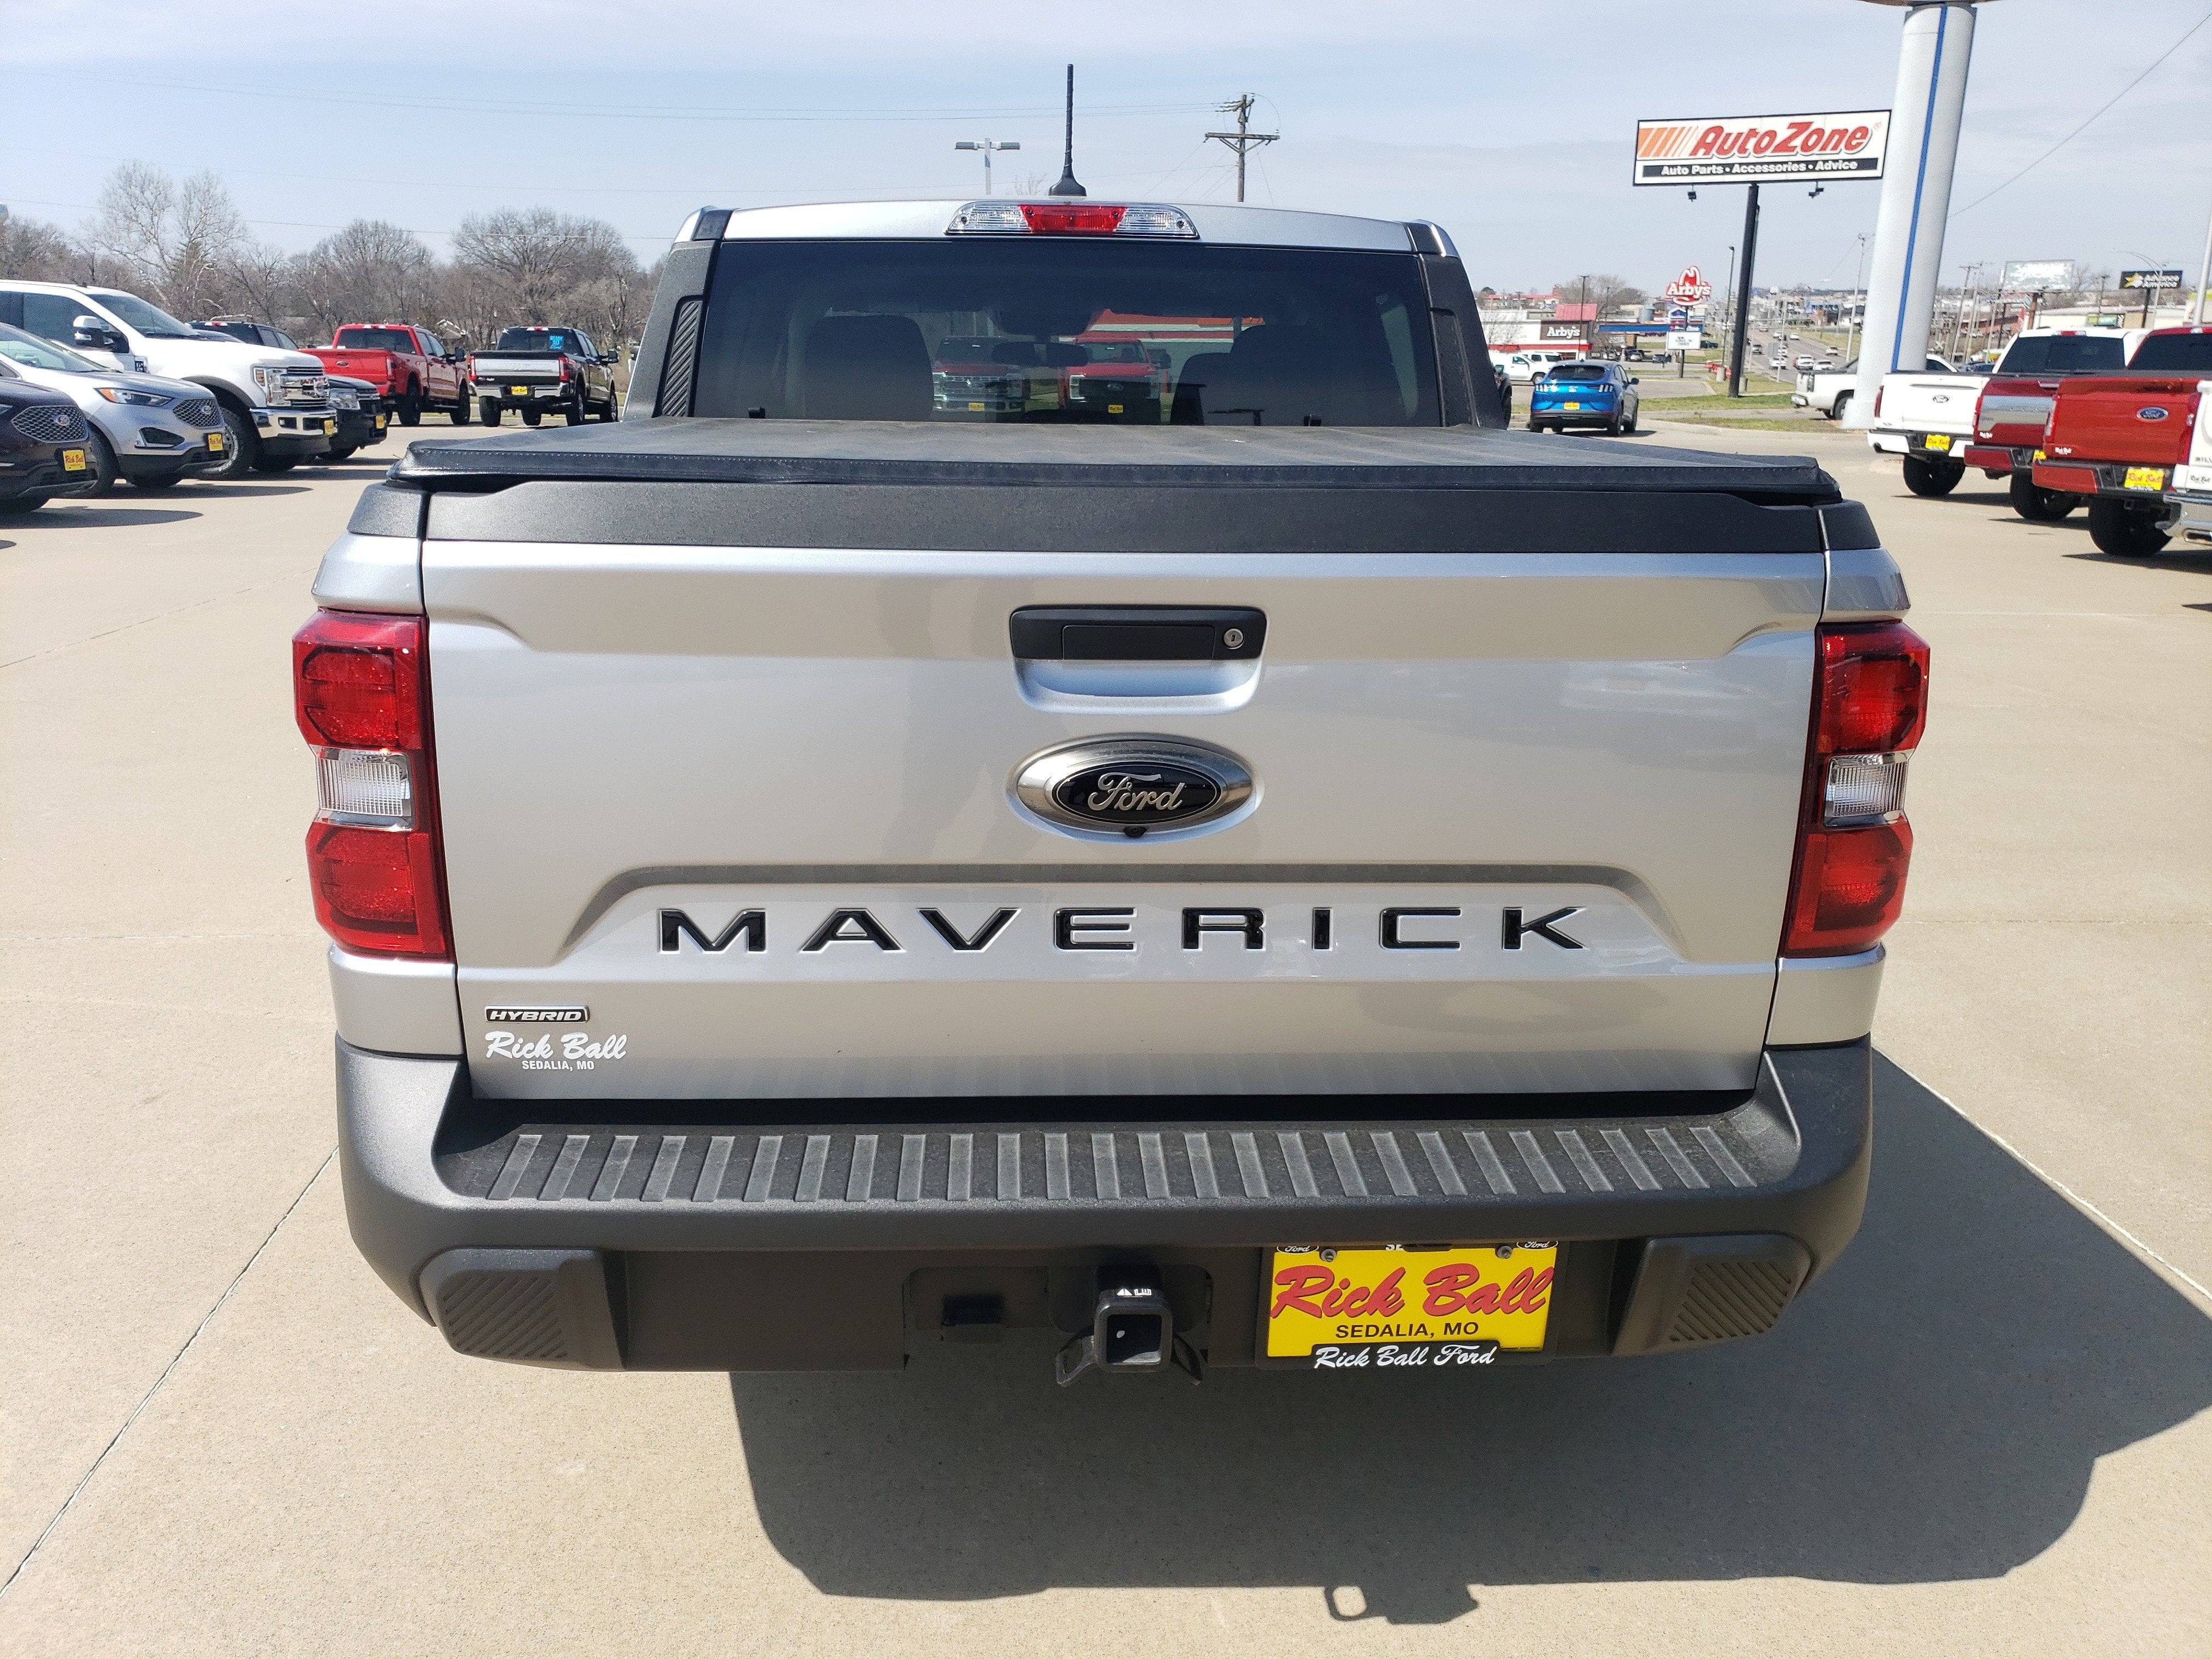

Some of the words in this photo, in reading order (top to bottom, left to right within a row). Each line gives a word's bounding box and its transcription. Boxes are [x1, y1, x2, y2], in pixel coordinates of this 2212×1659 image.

[1690, 121, 1872, 156] AutoZone
[1661, 164, 1689, 176] Auto
[1691, 163, 1724, 175] Parts
[1731, 161, 1807, 174] Accessories
[1815, 160, 1858, 171] Advice
[1667, 281, 1712, 298] Arby's
[1547, 326, 1580, 339] Arby's
[1087, 772, 1185, 811] Ford
[659, 907, 1587, 953] MAVERICK
[490, 1011, 582, 1021] HYBRID
[485, 1031, 554, 1059] Rick
[561, 1032, 627, 1059] Ball
[522, 1060, 573, 1071] SEDALIA,
[577, 1060, 594, 1069] MO
[1270, 1265, 1407, 1319] Rick
[1423, 1263, 1555, 1317] Ball
[1335, 1323, 1435, 1339] SEDALIA,
[1443, 1322, 1480, 1335] MO
[1314, 1346, 1370, 1368] Rick
[1376, 1345, 1429, 1366] Ball
[1434, 1344, 1496, 1365] Ford
